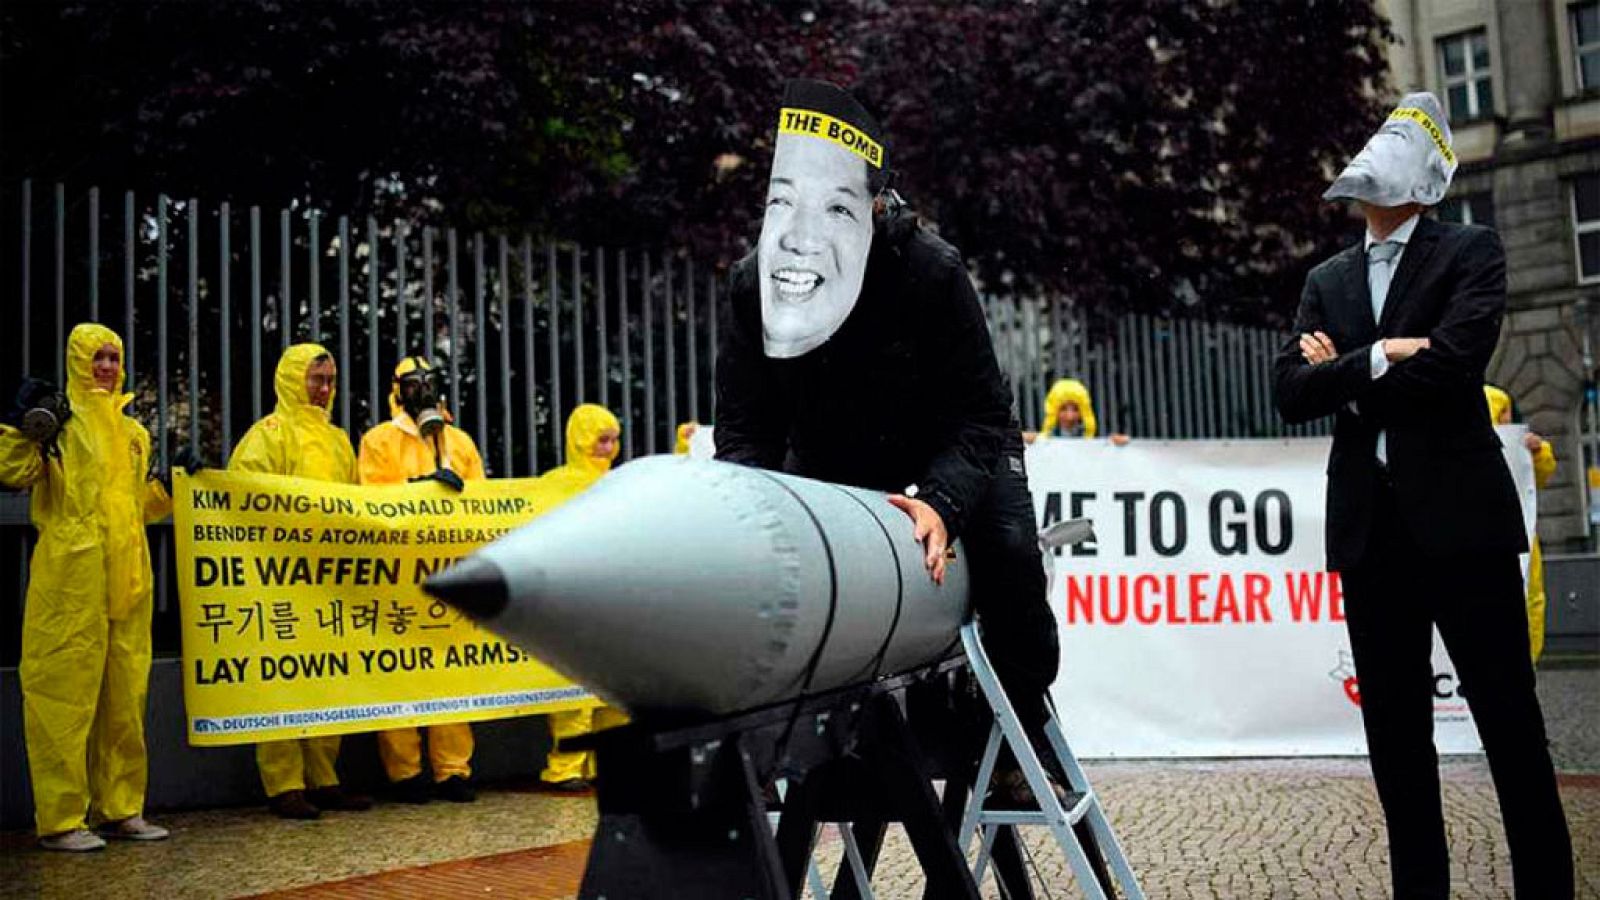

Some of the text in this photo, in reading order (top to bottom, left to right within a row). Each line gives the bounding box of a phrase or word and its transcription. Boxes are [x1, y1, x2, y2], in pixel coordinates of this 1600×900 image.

[785, 113, 879, 161] THE BOMB
[1421, 118, 1453, 161] BOMB
[193, 489, 534, 518] KIM JONG-UN, DONALD TRUMP:
[1113, 490, 1188, 558] TO
[1208, 488, 1294, 557] GO
[193, 524, 267, 542] BEENDET
[272, 527, 313, 543] DAS
[319, 529, 409, 545] ATOMARE
[194, 555, 245, 588] DIE
[255, 556, 401, 586] WAFFEN
[1066, 572, 1273, 625] NUCLEAR
[195, 599, 460, 645] 무기를 내려놓으
[195, 656, 249, 685] LAY
[260, 652, 349, 681] DOWN
[358, 646, 435, 673] YOUR
[222, 713, 280, 731] DEUTSCHE
